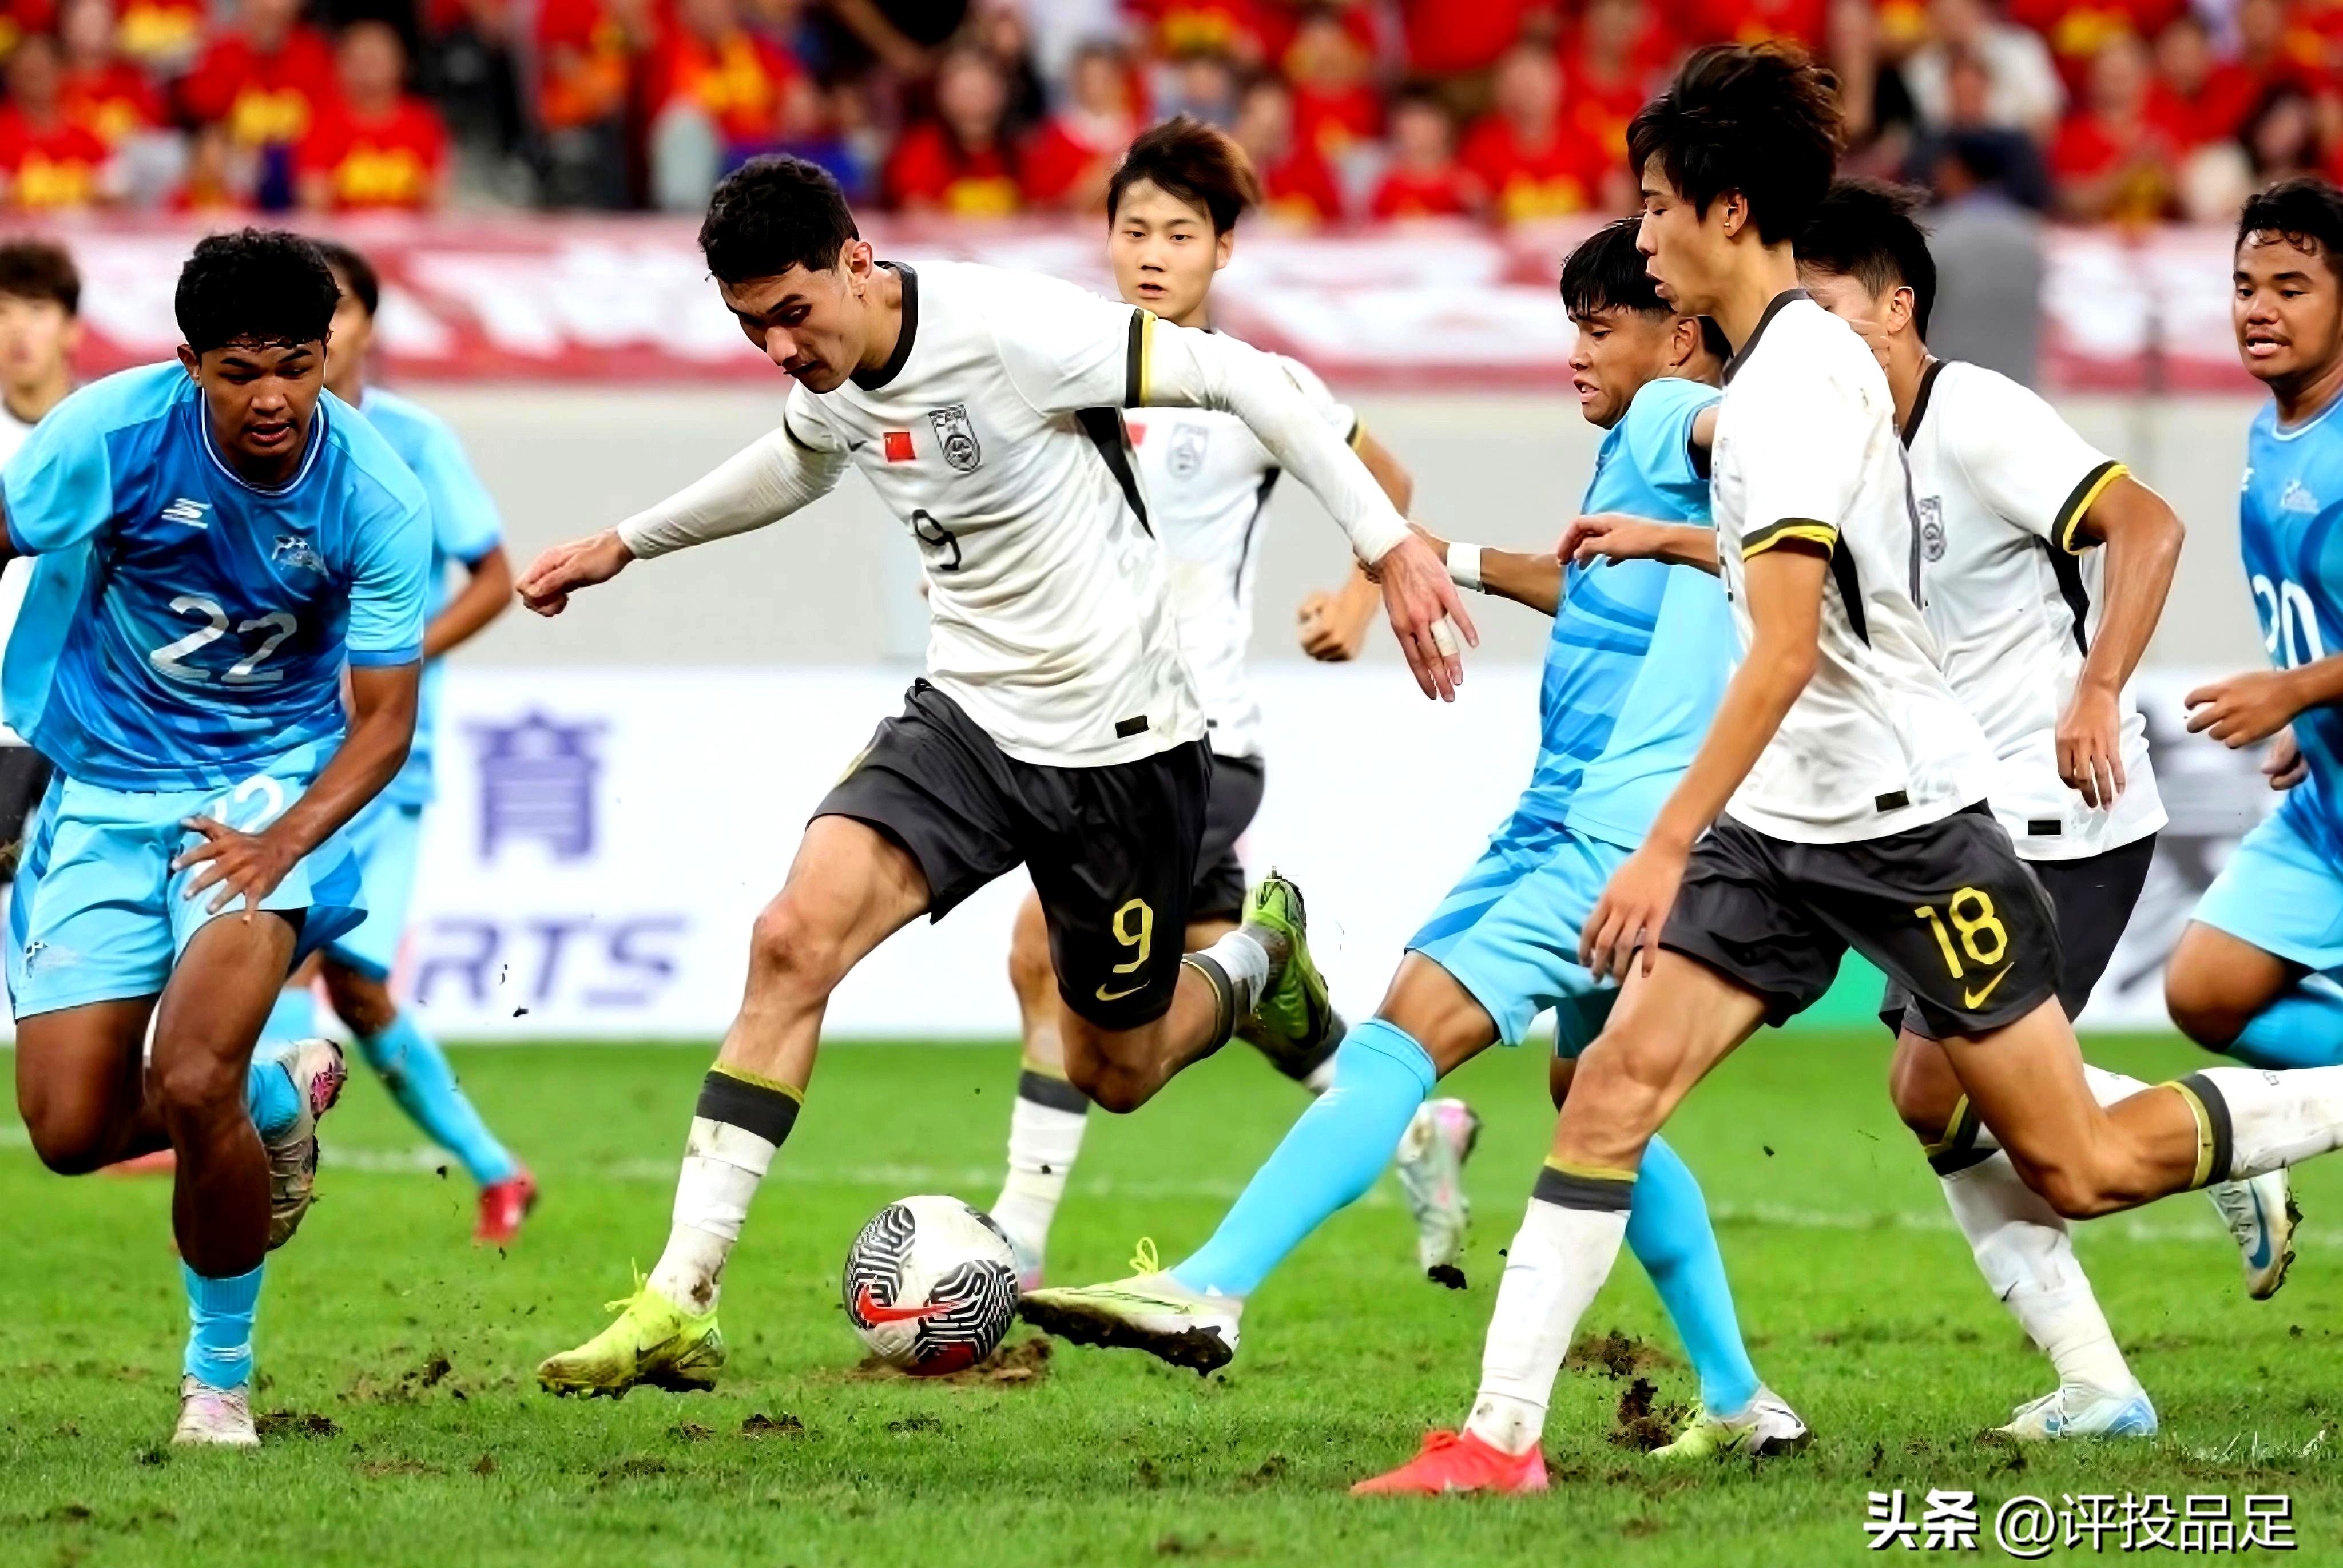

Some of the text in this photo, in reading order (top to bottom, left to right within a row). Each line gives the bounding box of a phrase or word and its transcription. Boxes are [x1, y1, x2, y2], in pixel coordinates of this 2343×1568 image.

[912, 509, 962, 571] 9
[149, 595, 297, 684] 22
[1112, 897, 1154, 974] 9
[1914, 887, 2008, 979] 18
